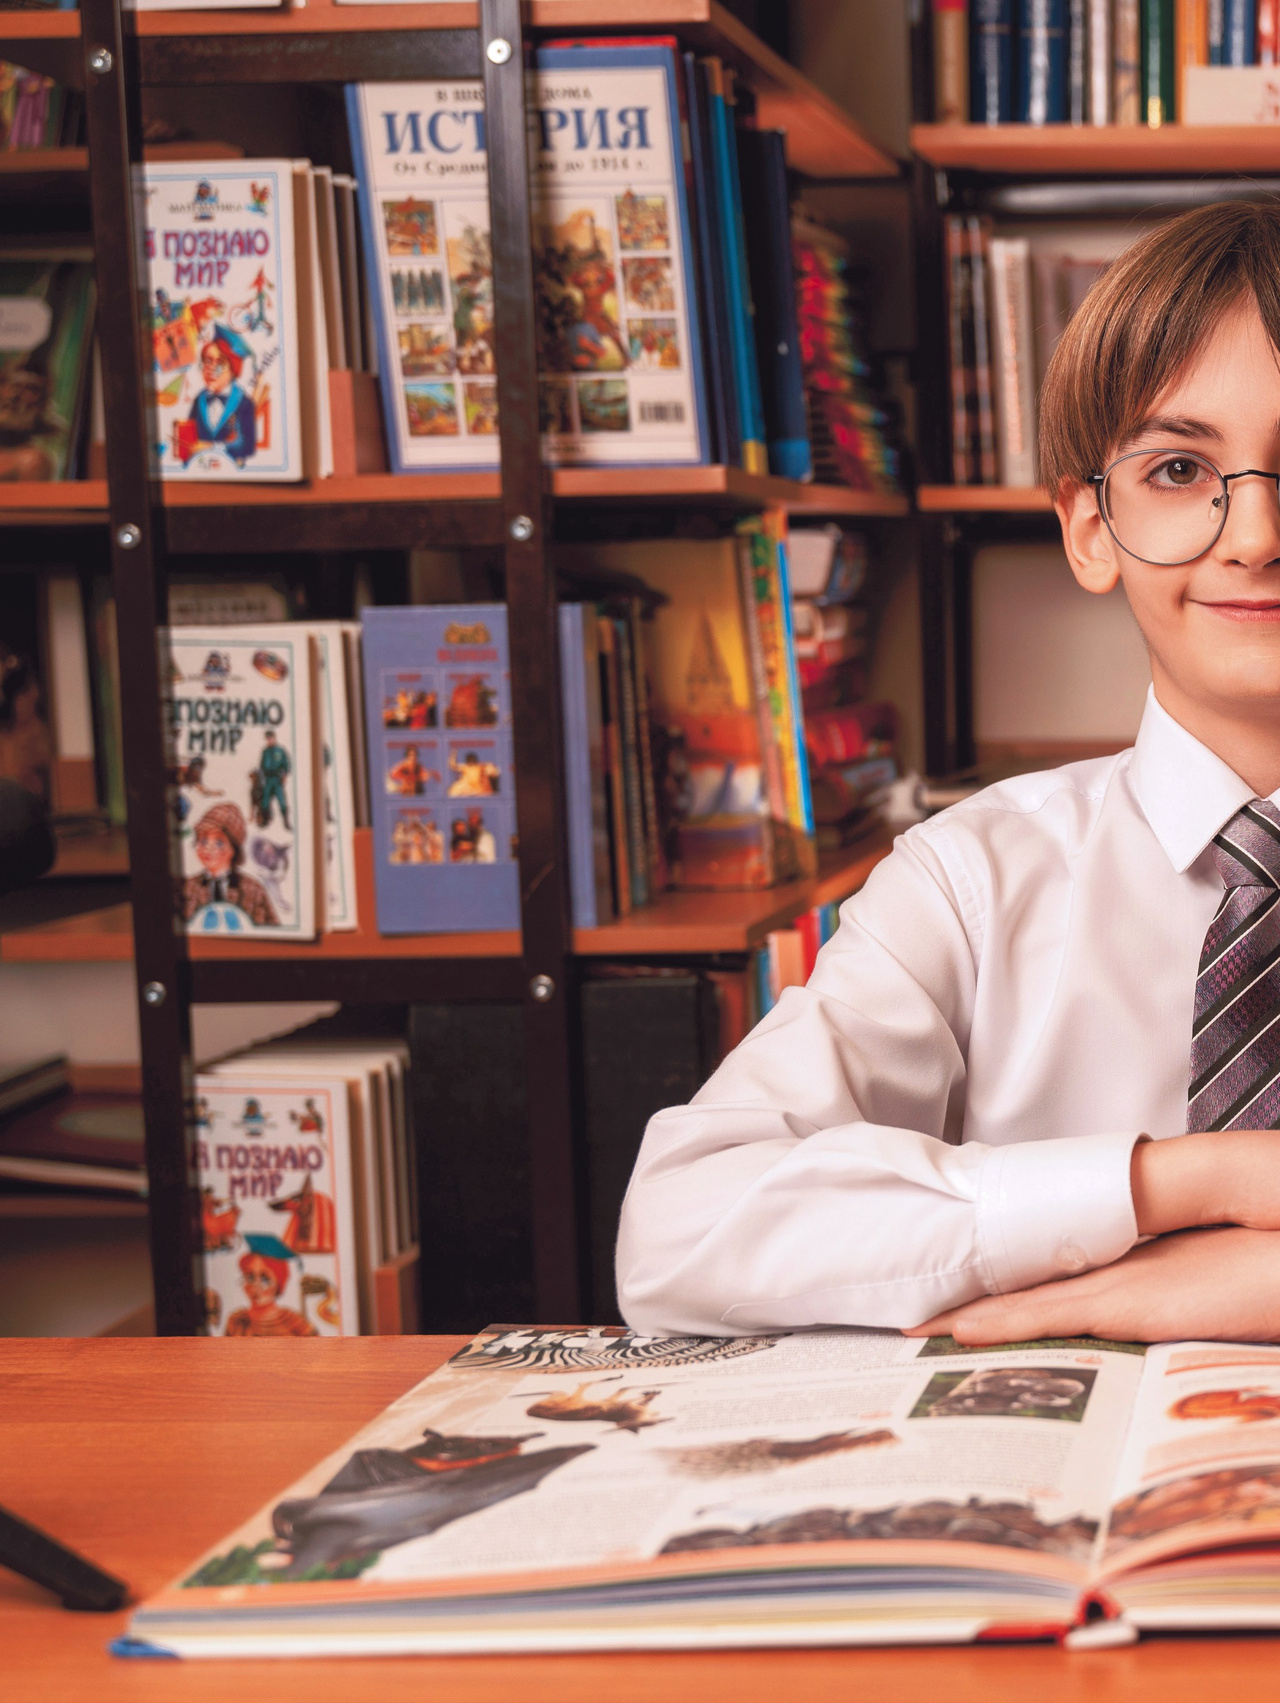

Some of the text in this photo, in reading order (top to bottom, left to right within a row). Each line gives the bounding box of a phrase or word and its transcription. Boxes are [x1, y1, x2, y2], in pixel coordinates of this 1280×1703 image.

[380, 104, 653, 156] ИСТРИЯ
[163, 228, 270, 258] ПОЗНАЮ
[174, 260, 231, 287] МИР
[188, 726, 244, 754] МИР
[215, 1143, 324, 1173] ПОЗНАЮ
[228, 1172, 284, 1198] МИР
